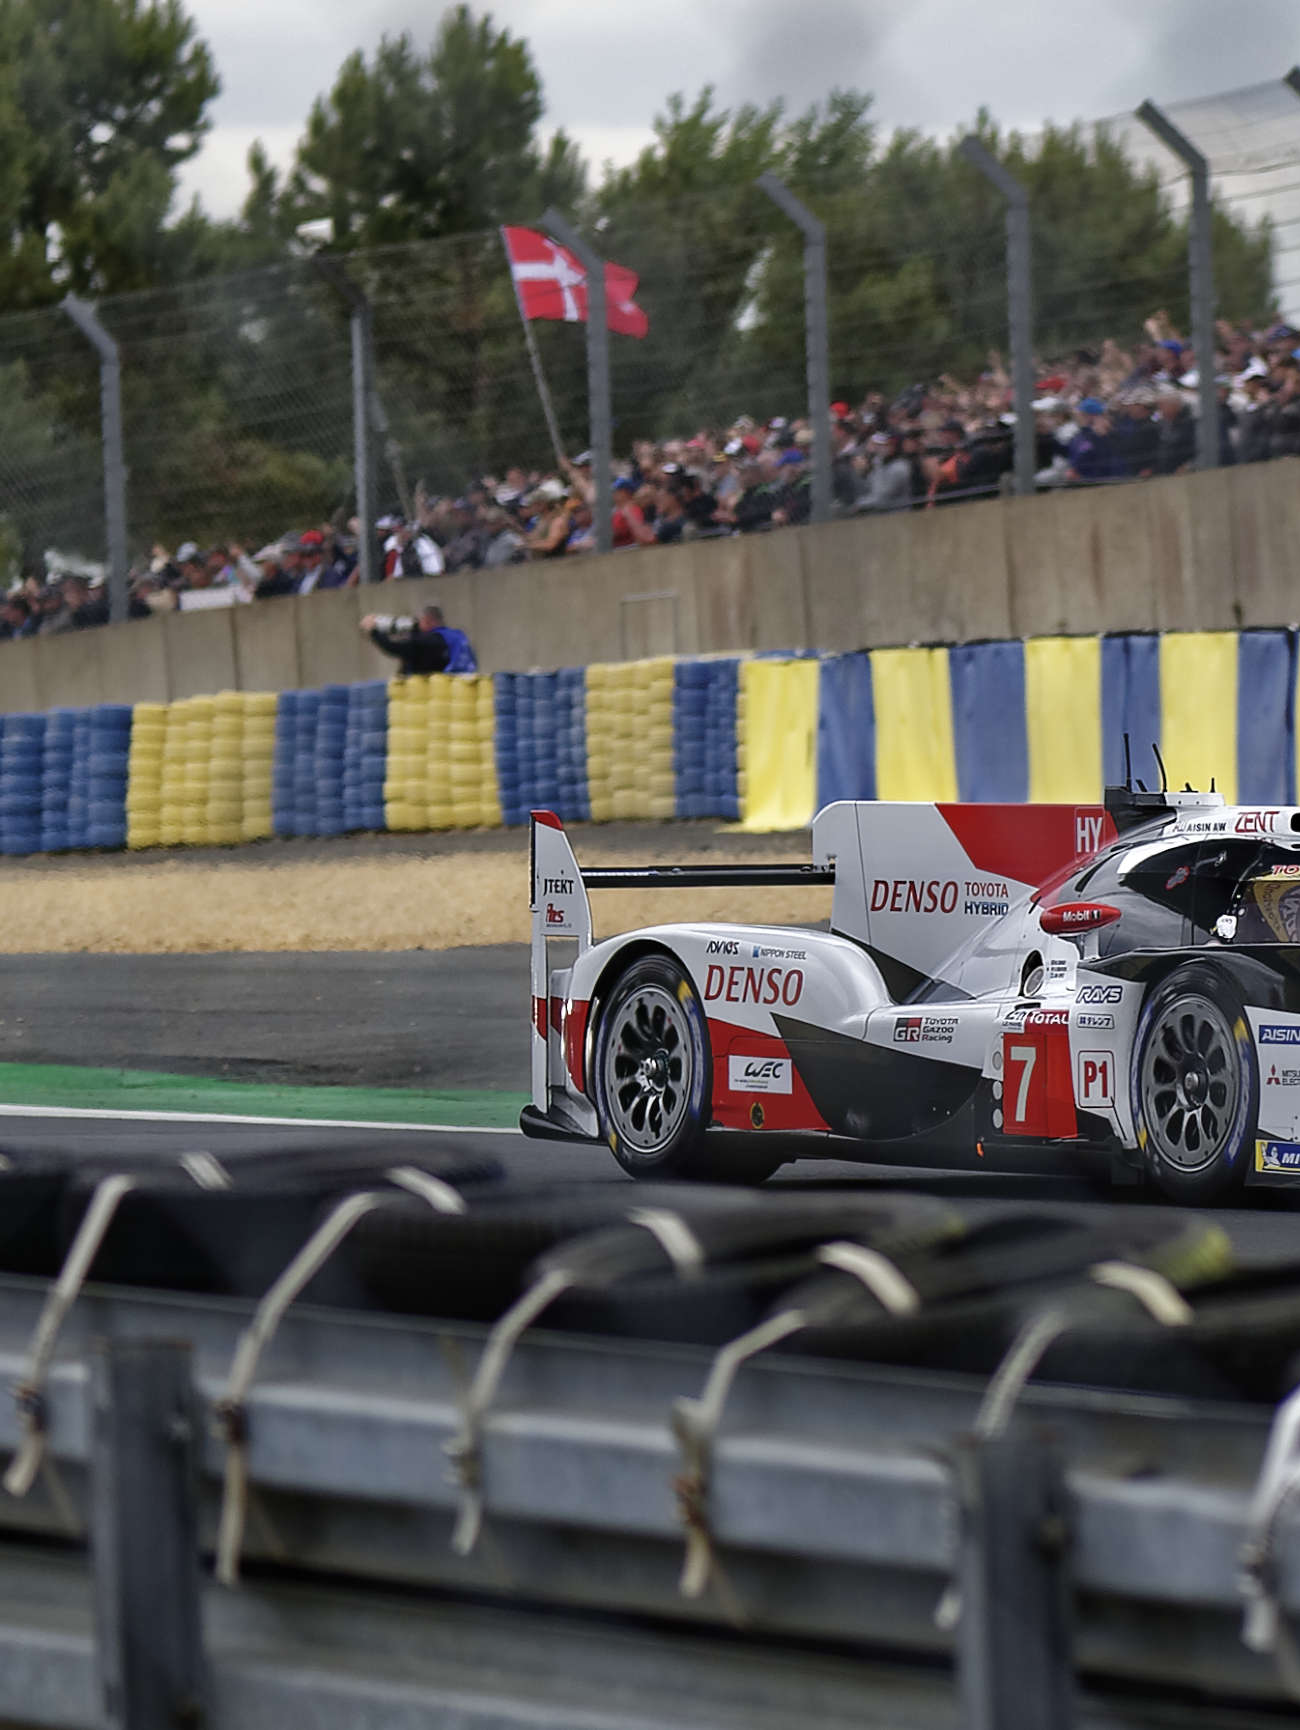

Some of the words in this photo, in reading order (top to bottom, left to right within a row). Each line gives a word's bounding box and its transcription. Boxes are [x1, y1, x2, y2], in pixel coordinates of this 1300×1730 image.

[1187, 823, 1211, 831] AISIN
[1213, 822, 1226, 831] AW
[1235, 811, 1280, 833] ZENT
[1077, 816, 1103, 853] HY
[543, 879, 574, 896] JTEKT
[964, 882, 1009, 898] TOYOTA
[870, 880, 959, 913] DENSO
[964, 901, 1009, 916] HYBRID
[1063, 910, 1089, 922] Mobil
[785, 951, 806, 960] STEEL
[704, 965, 804, 1006] DENSO
[1076, 986, 1123, 1003] RAYS
[925, 1017, 959, 1025] TOYOTA
[1028, 1011, 1069, 1024] TOTAL
[895, 1027, 920, 1040] GR
[922, 1034, 953, 1044] Racing
[744, 1061, 784, 1079] WEC
[1011, 1046, 1037, 1122] 7
[1084, 1060, 1108, 1098] P1
